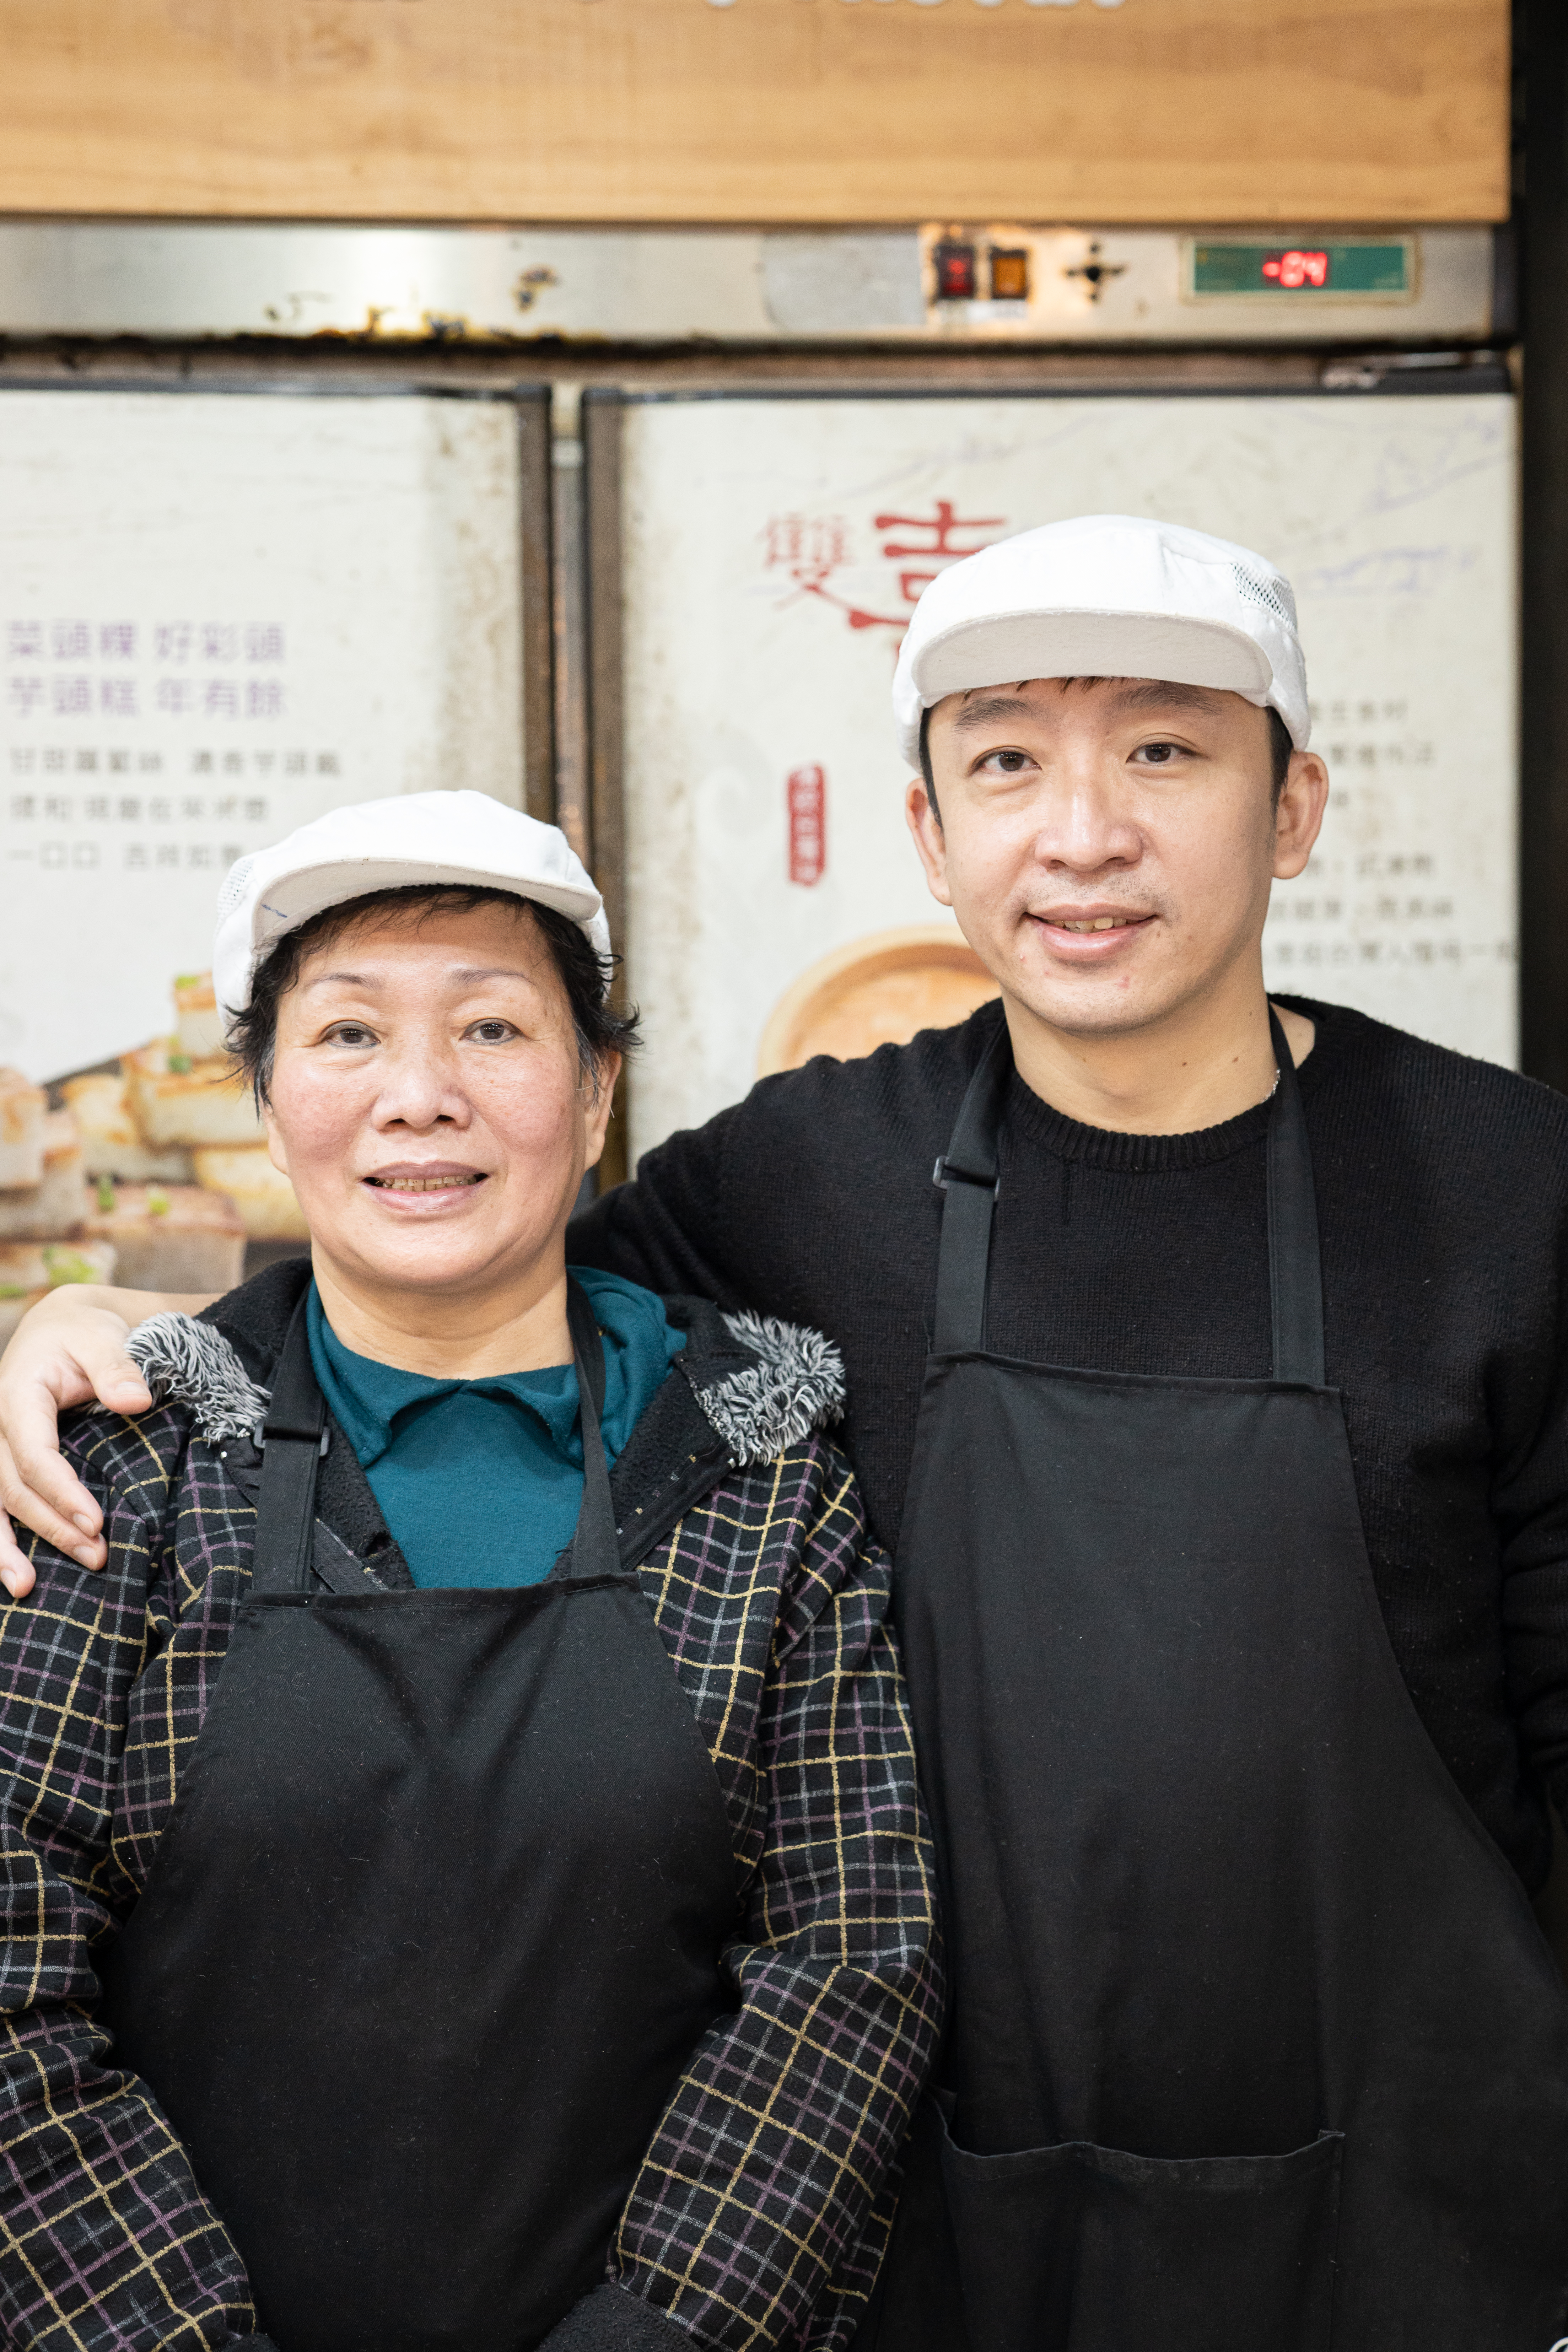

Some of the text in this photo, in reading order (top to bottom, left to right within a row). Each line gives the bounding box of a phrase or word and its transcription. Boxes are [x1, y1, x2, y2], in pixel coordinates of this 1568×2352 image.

[6, 619, 286, 664] 菜頭粿 好彩頭
[6, 676, 287, 719] 芋頭糕 年有餘
